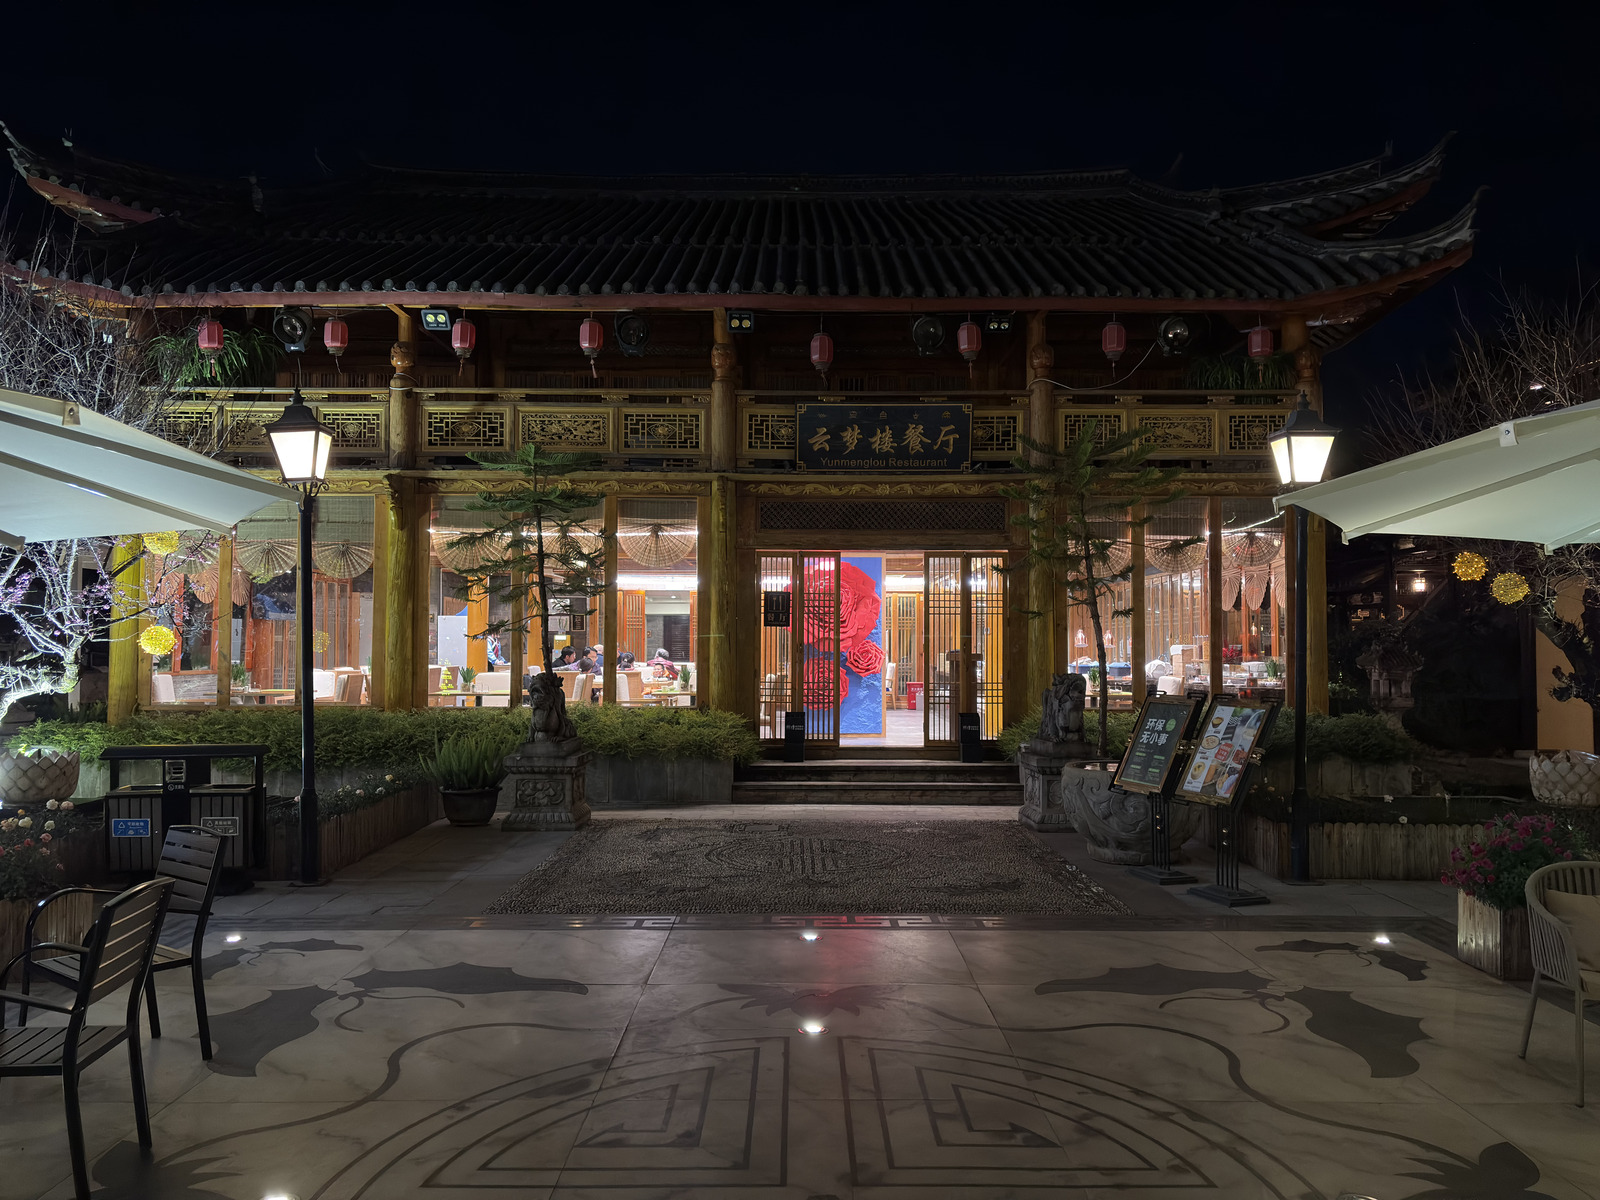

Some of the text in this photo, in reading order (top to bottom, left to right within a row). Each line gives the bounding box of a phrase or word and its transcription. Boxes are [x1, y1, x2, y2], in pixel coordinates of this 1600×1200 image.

[808, 423, 960, 456] 云梦楼餐厅
[820, 457, 948, 469] Yunmenglou Restaurant
[1145, 718, 1166, 732] 环保
[1139, 731, 1169, 746] 无小事
